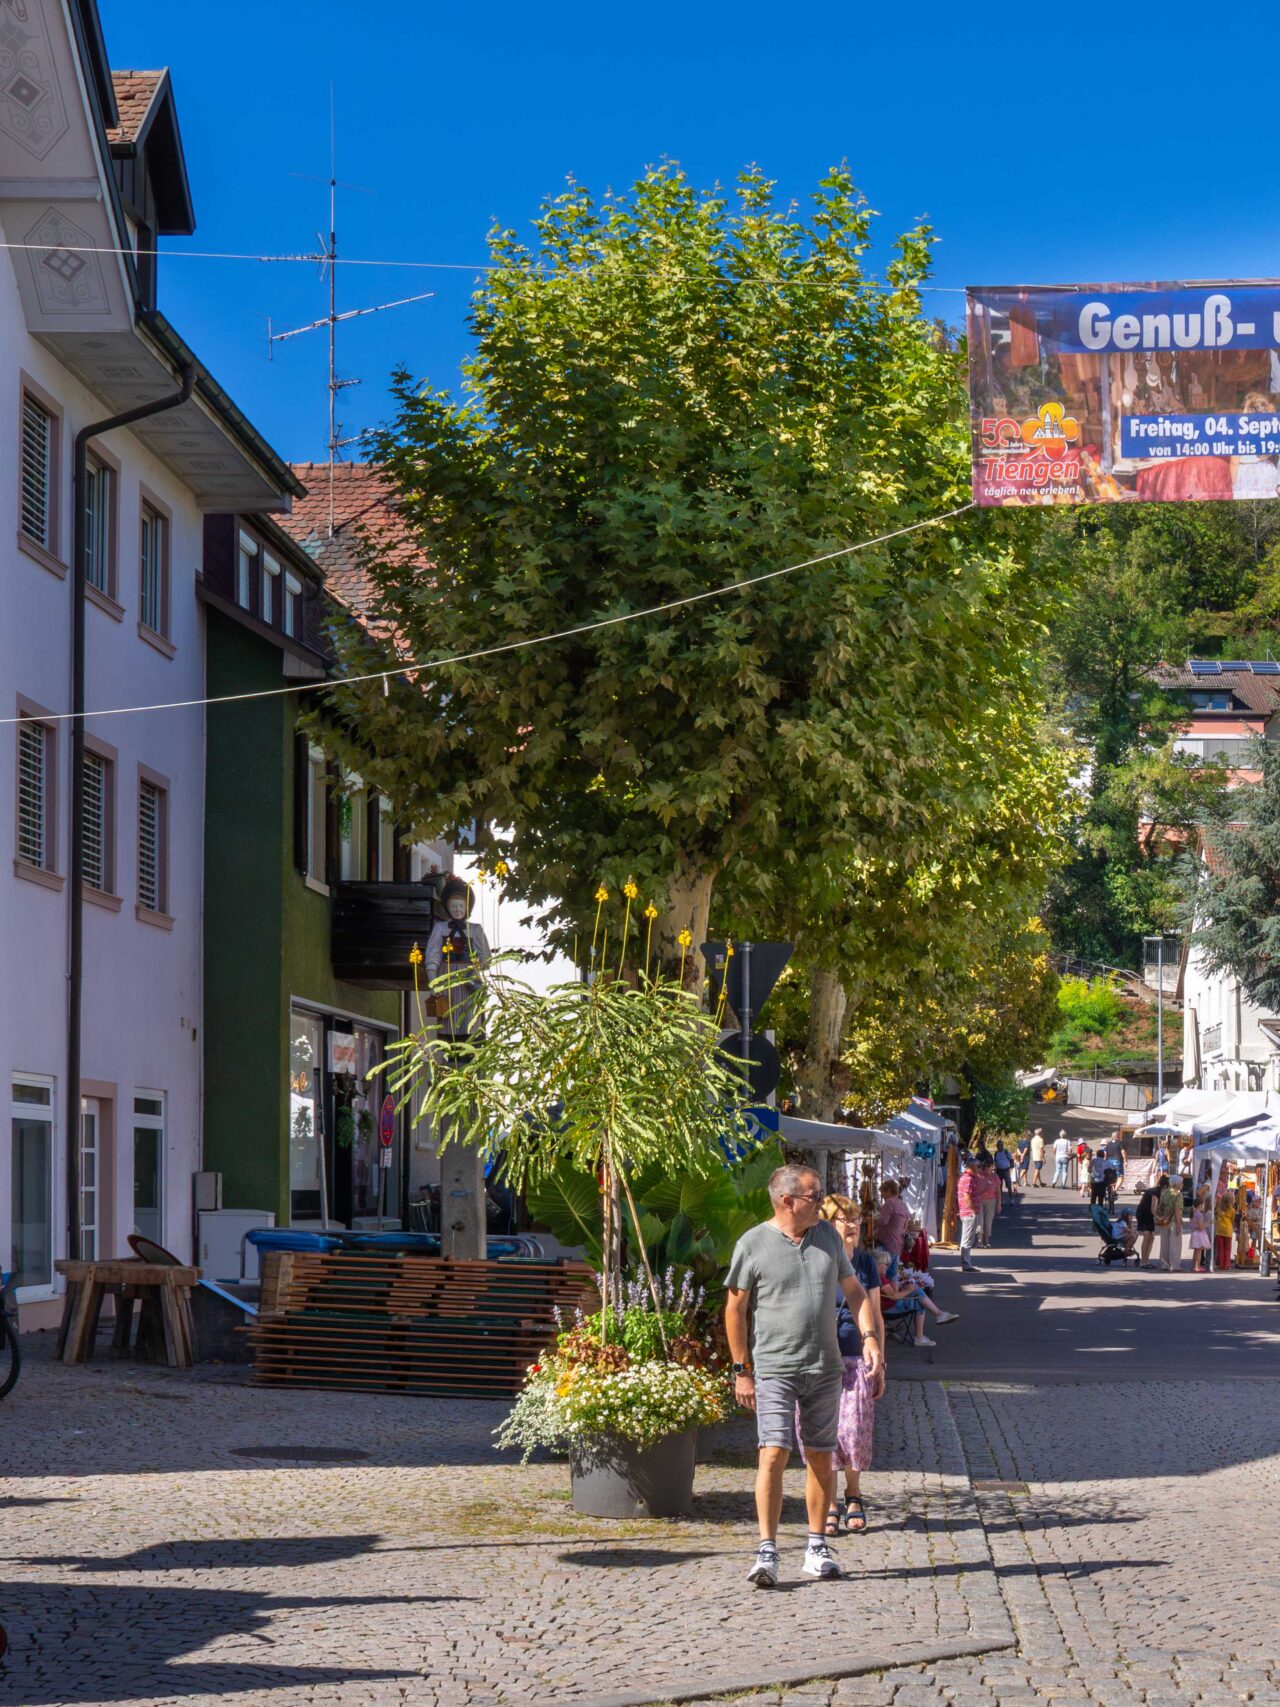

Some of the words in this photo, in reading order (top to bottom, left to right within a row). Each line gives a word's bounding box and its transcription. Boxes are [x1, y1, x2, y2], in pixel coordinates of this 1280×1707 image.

[1078, 294, 1256, 350] Genuß-
[981, 417, 1021, 448] 50
[1129, 416, 1200, 441] Freitag,
[1204, 416, 1234, 436] 04.
[1149, 445, 1173, 456] von
[1175, 441, 1209, 456] 14:00
[1212, 440, 1235, 455] Uhr
[1236, 438, 1256, 454] bis
[982, 456, 1080, 487] Tiengen
[984, 485, 1018, 498] täglich
[1019, 487, 1038, 496] neu
[1039, 484, 1081, 496] erleben!
